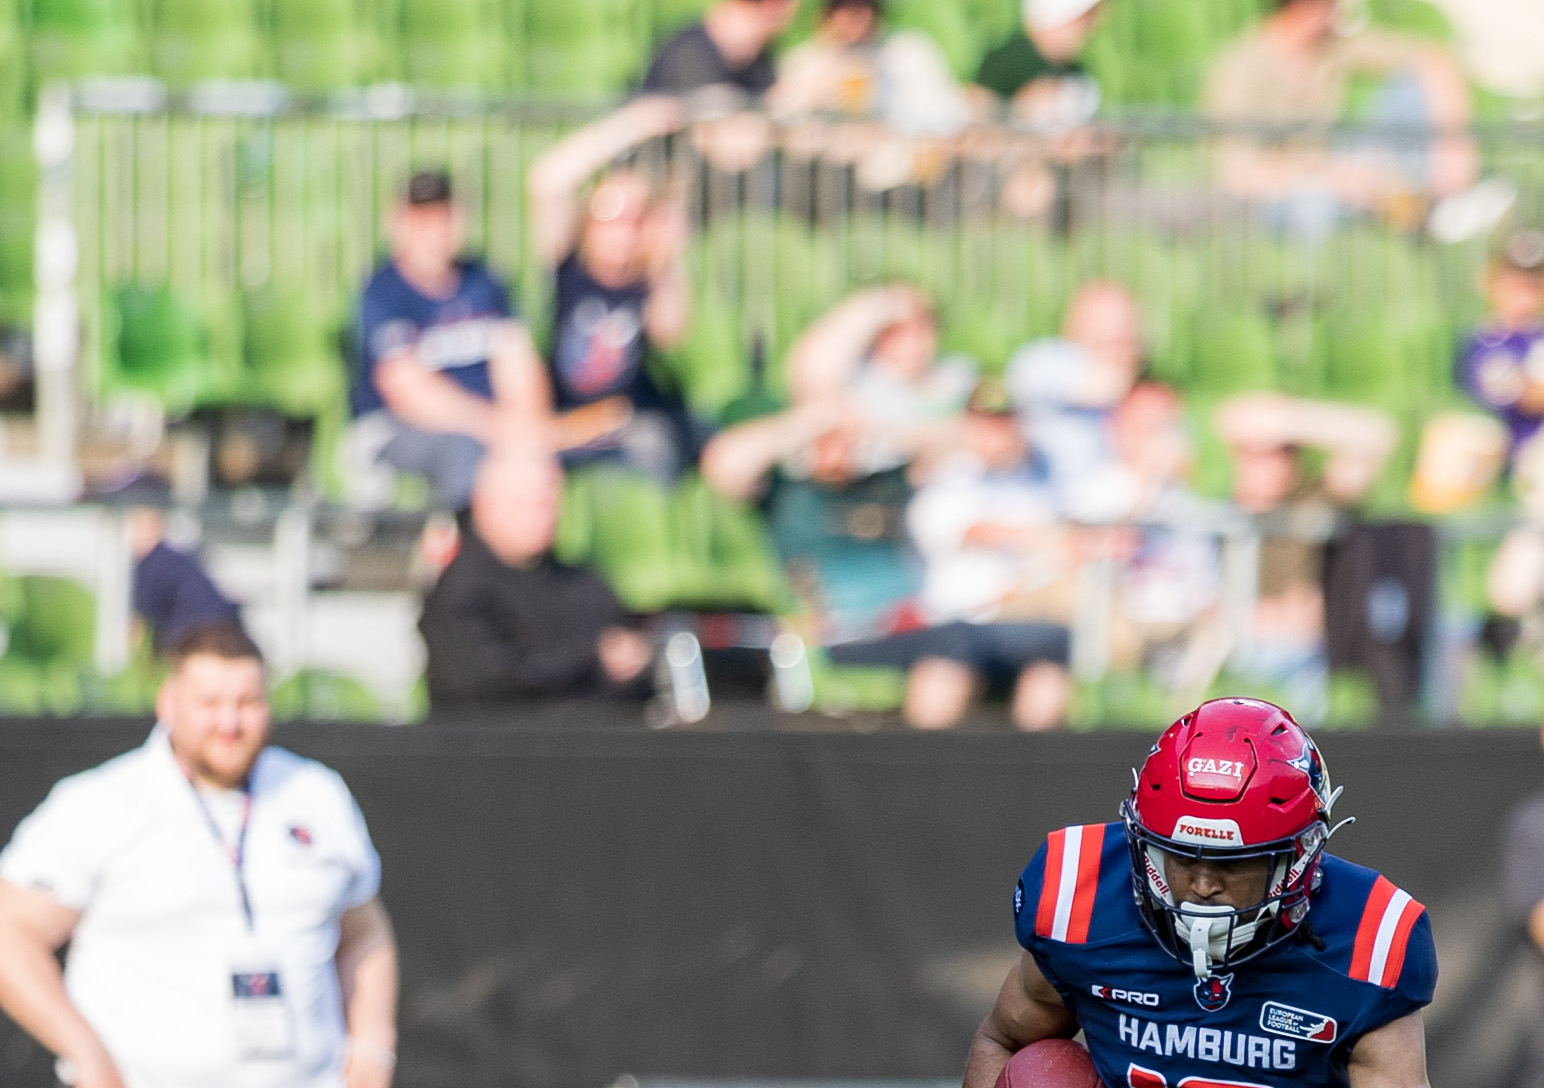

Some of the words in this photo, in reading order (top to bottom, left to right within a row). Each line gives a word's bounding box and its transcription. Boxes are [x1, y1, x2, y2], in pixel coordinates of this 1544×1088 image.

[1187, 757, 1244, 777] GAZI
[1179, 824, 1235, 841] FORELLE
[1268, 1013, 1293, 1026] LEAGUE
[1269, 1007, 1304, 1022] EUROPEAN
[1267, 1020, 1300, 1034] FOOTBALL
[1118, 1012, 1297, 1070] HAMBURG
